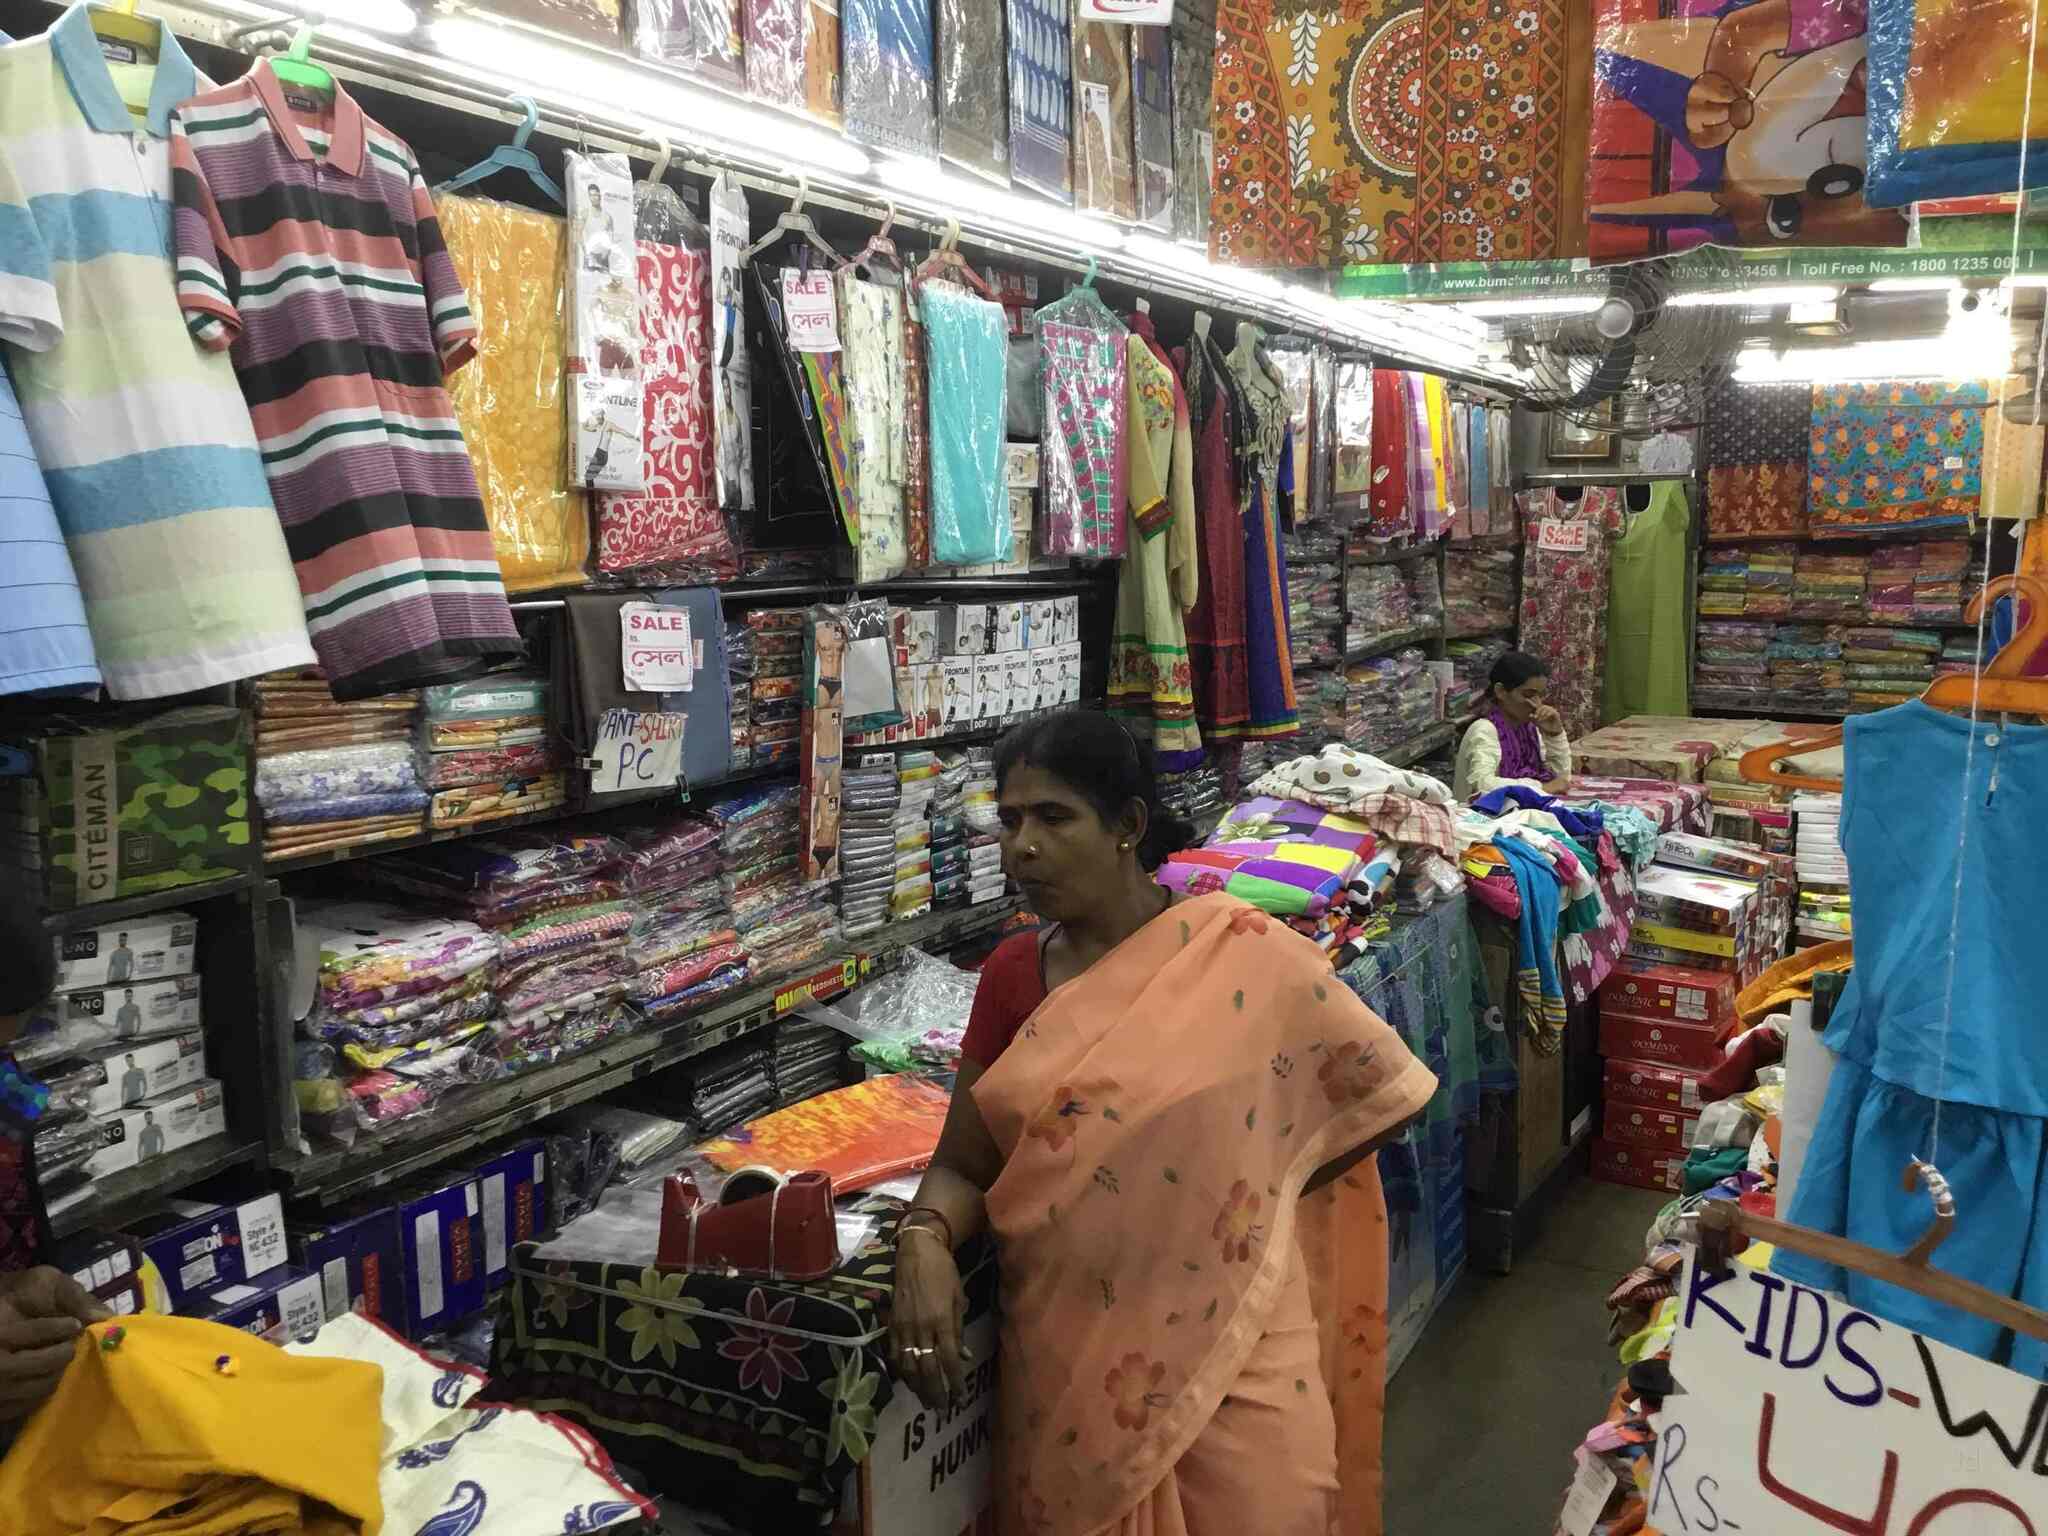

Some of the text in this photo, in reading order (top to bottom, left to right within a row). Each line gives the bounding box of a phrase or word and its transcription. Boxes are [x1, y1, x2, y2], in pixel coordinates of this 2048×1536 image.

[1800, 263, 1827, 276] Toll
[1832, 261, 1865, 275] Free
[1869, 260, 1896, 274] No.
[1911, 258, 1947, 272] 1800
[1952, 256, 1990, 271] 1235
[785, 280, 828, 296] SALE
[630, 614, 684, 631] SALE
[903, 1411, 926, 1462] IS
